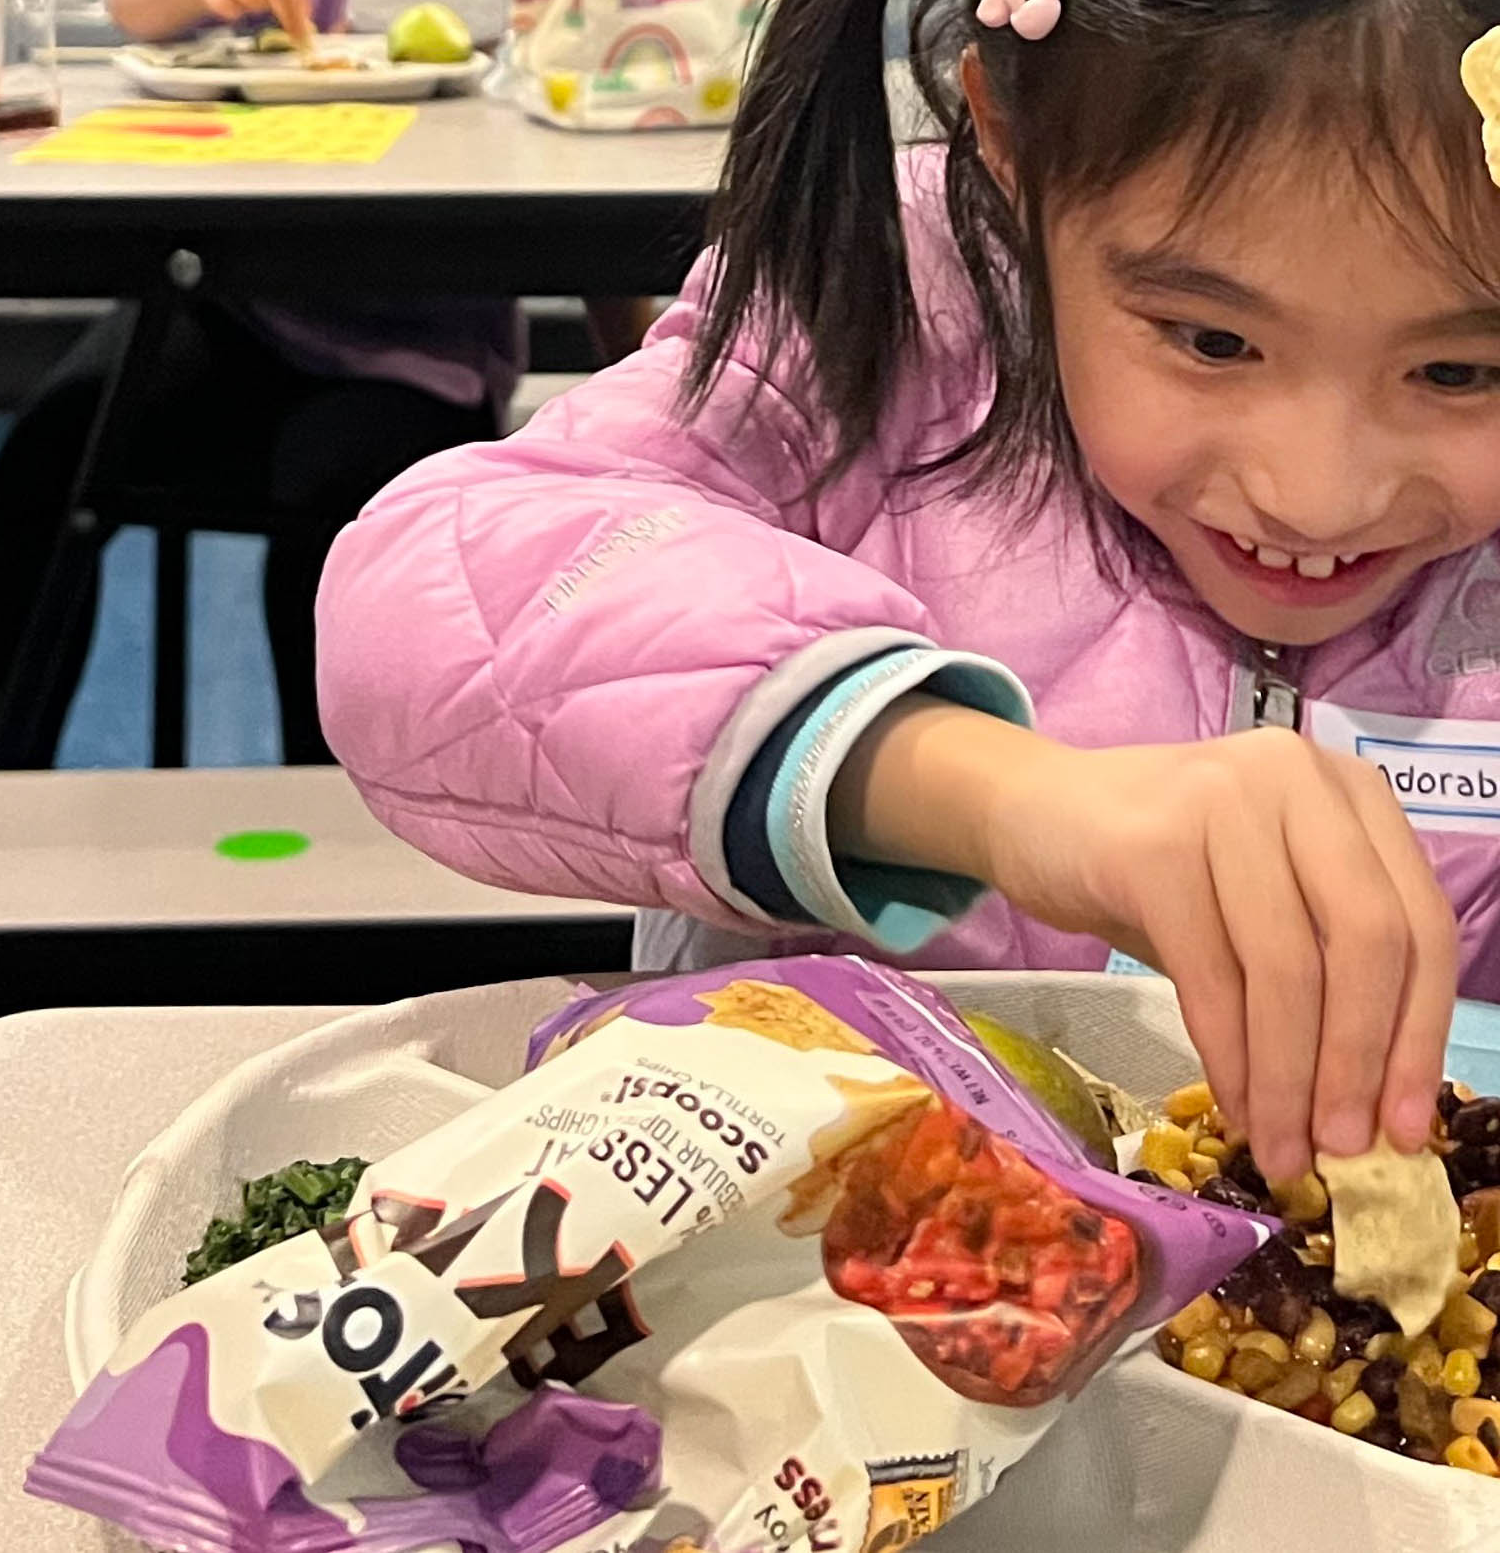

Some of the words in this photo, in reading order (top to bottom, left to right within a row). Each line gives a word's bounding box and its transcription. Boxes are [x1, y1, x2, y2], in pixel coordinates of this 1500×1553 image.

[636, 1056, 693, 1082] CHIPS
[699, 1080, 787, 1149] TORTILLA
[588, 1128, 695, 1227] LESS
